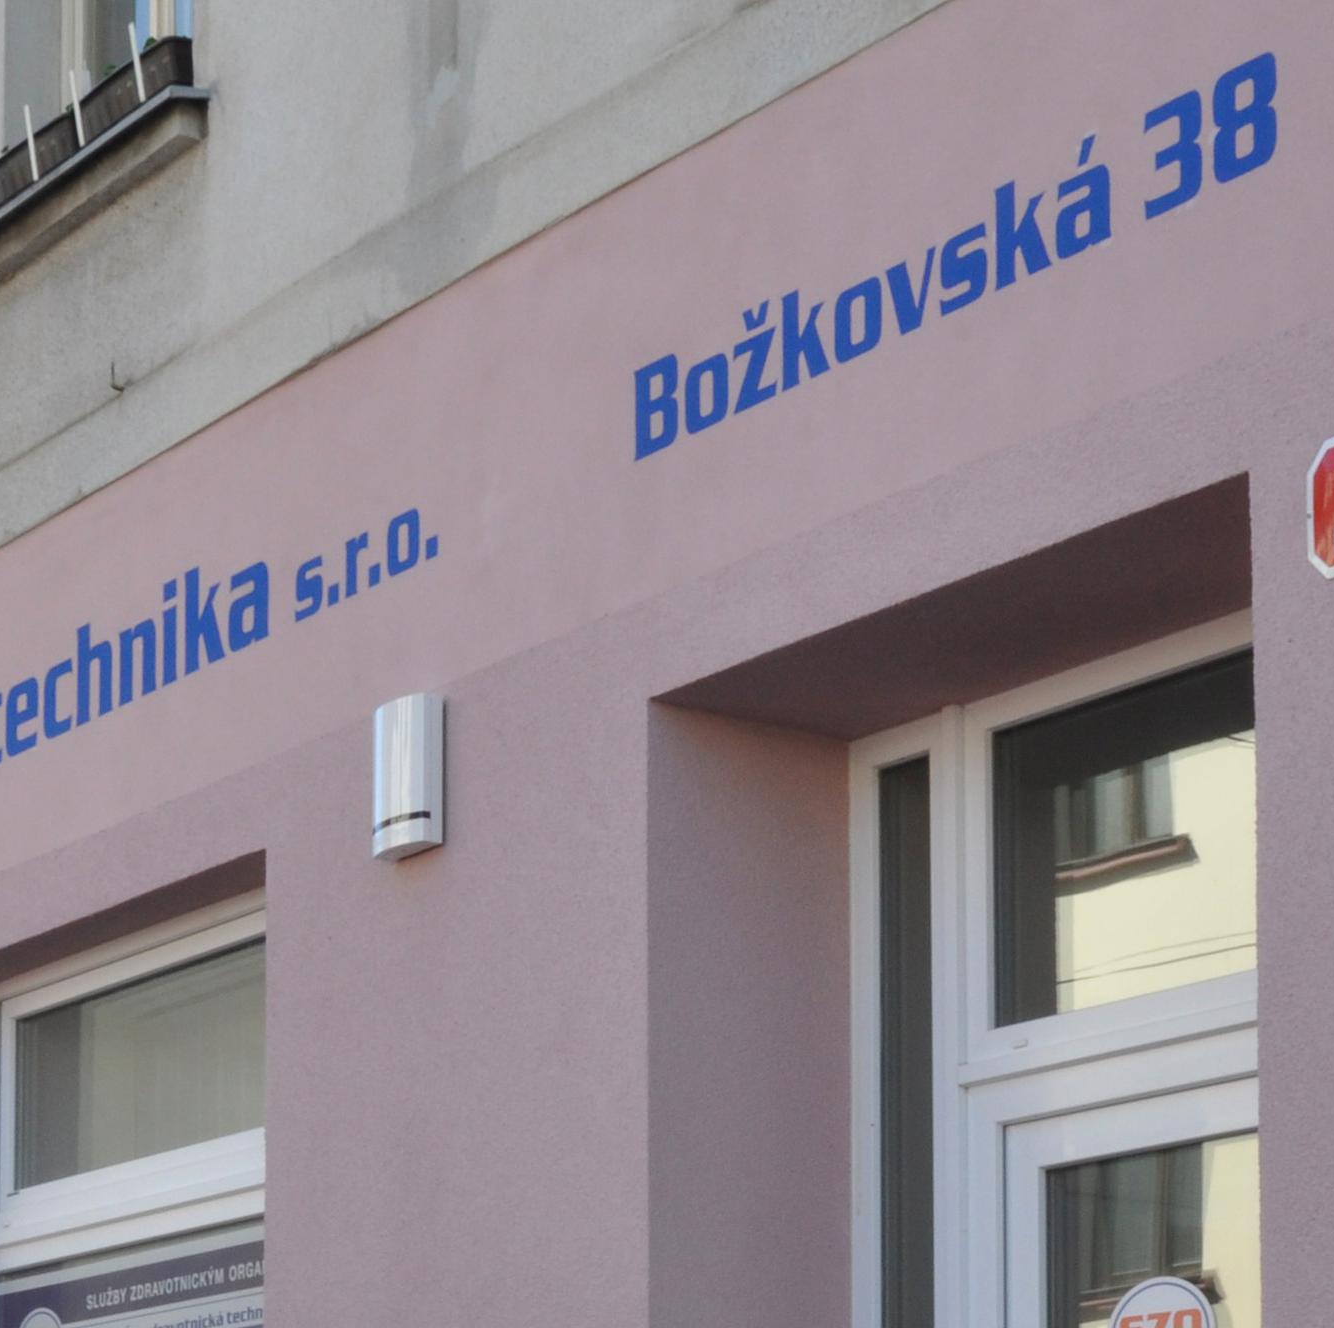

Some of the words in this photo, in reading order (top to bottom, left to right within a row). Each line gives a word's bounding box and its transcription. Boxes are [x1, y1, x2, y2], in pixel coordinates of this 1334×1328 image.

[634, 135, 1112, 461] Božkovská
[1144, 52, 1278, 220] 38
[294, 508, 439, 622] s.r.o.
[85, 1285, 127, 1310] SLUŽBY
[130, 1265, 225, 1302] ZDRAVOTNICKÝM
